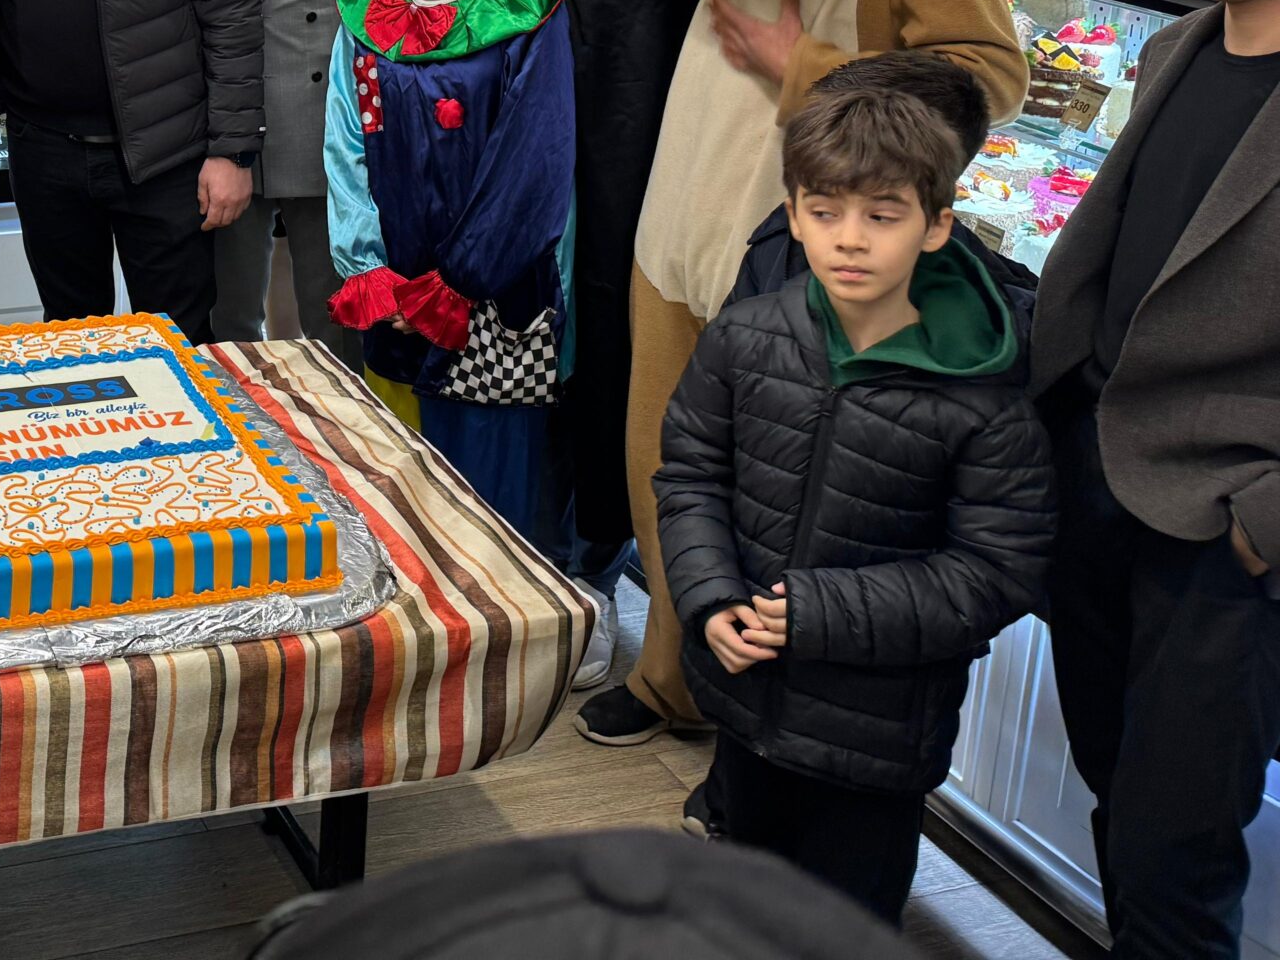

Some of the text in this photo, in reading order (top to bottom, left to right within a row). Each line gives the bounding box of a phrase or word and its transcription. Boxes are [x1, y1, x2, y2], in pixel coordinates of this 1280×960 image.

[1071, 99, 1090, 114] 330
[27, 401, 148, 423] Biz bir aileyiz
